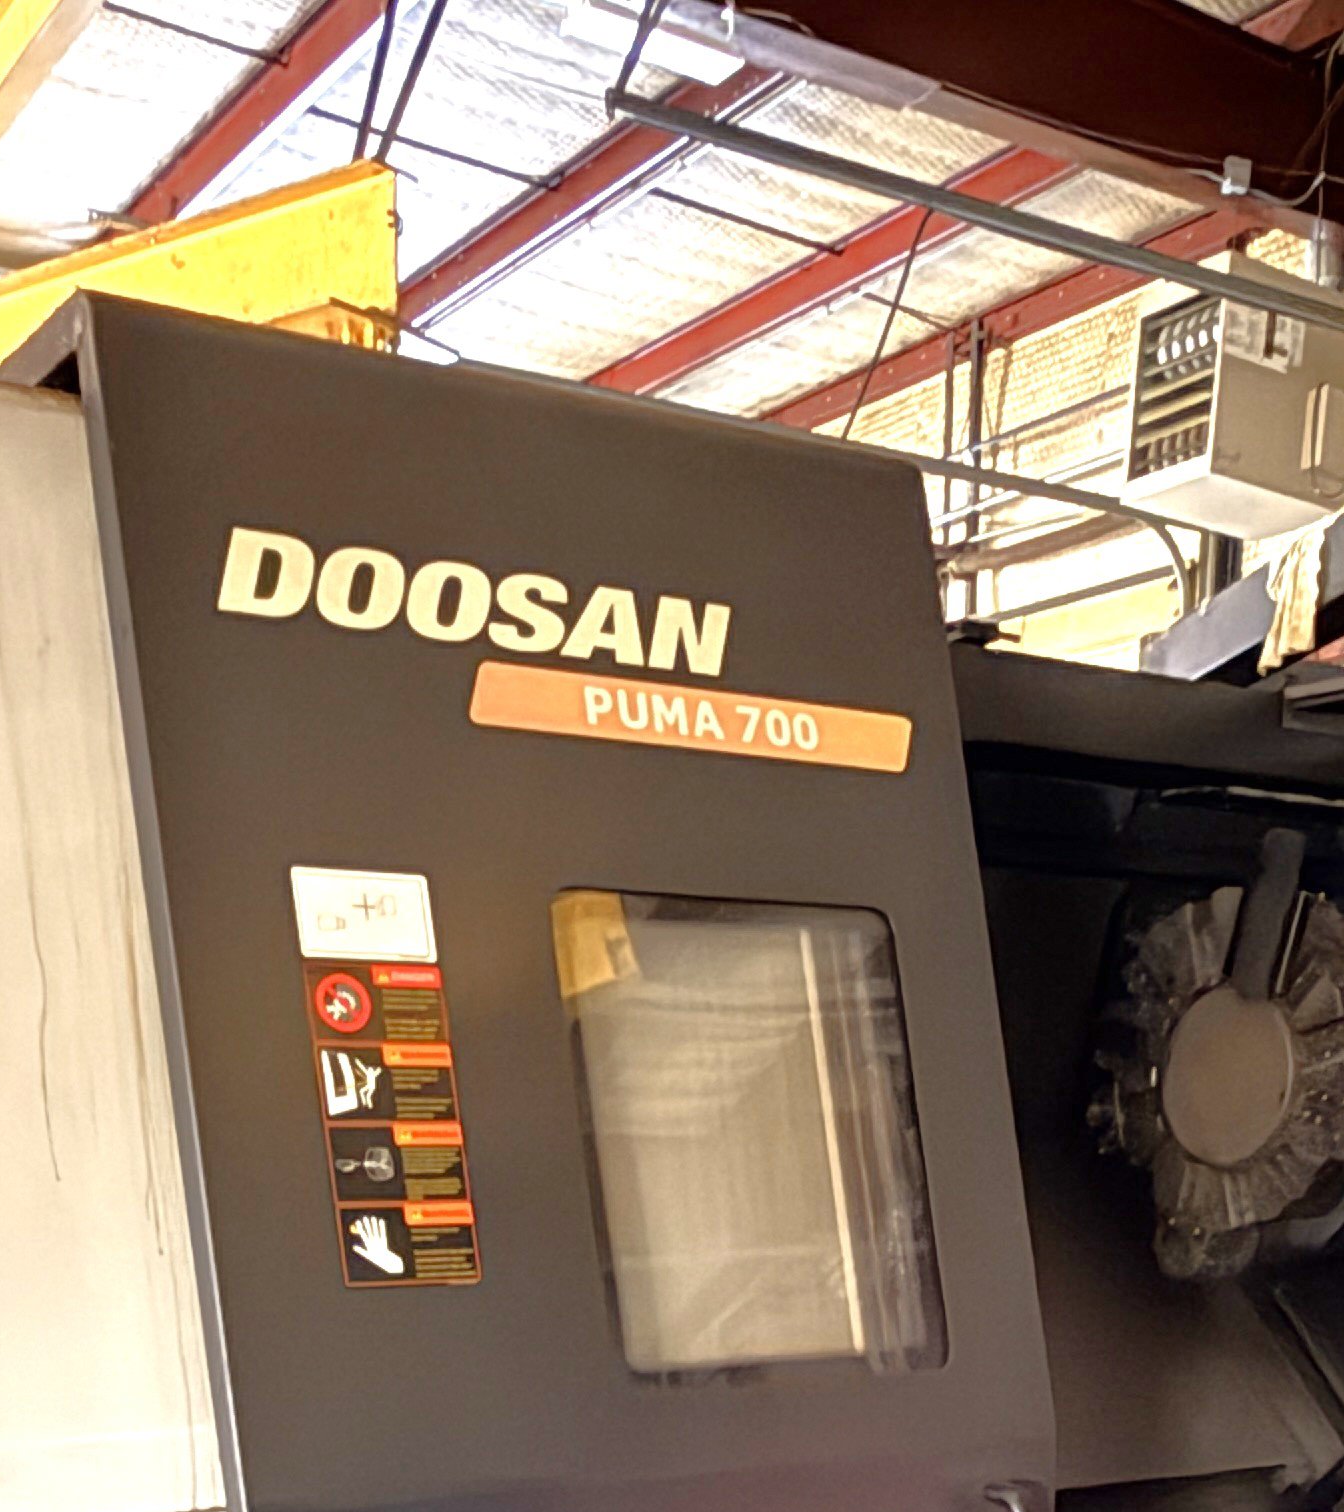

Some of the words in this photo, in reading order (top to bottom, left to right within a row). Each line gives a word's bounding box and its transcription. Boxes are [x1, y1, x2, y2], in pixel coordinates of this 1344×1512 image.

[217, 526, 732, 677] DOOSAN
[583, 685, 726, 742] PUMA
[735, 705, 820, 751] 700
